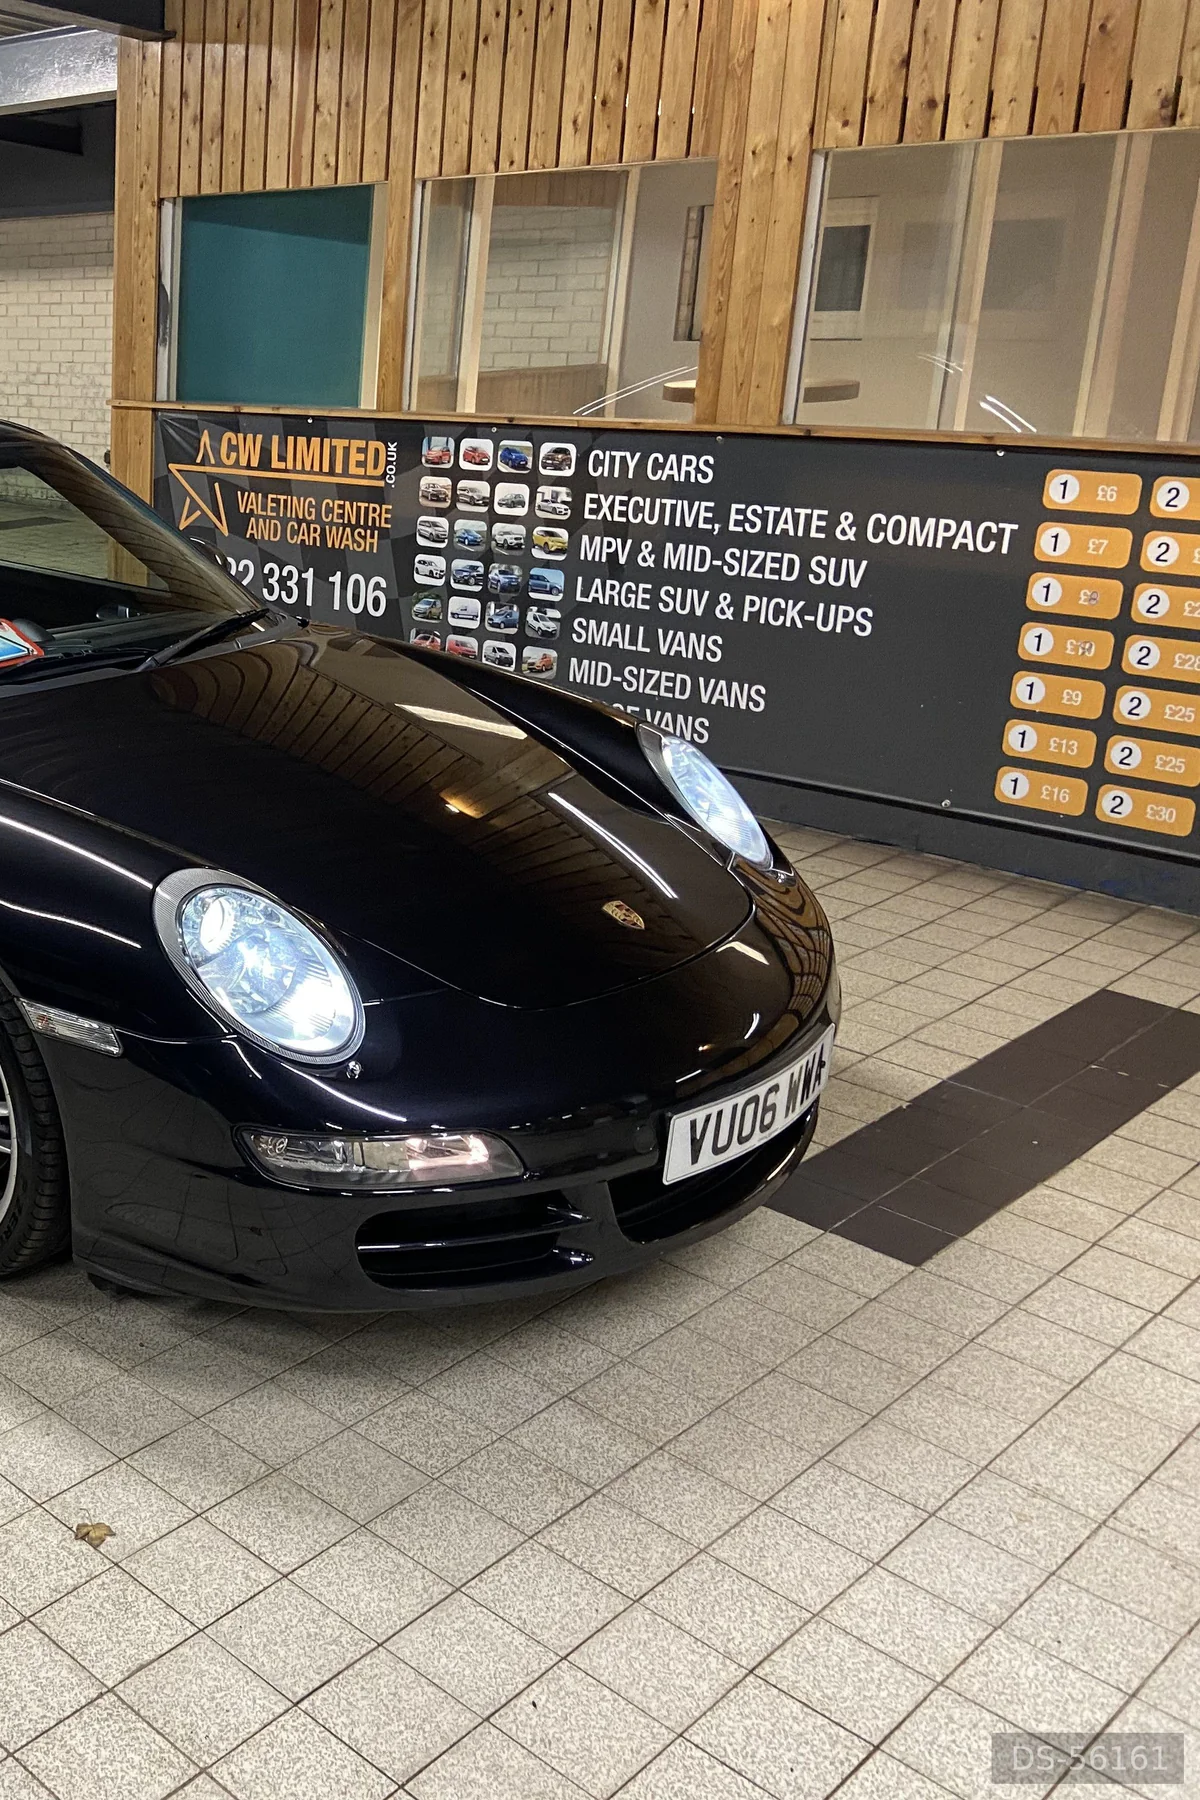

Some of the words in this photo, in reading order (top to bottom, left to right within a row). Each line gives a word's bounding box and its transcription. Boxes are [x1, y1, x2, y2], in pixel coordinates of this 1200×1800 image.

[220, 432, 262, 467] CW
[271, 435, 387, 477] LIMITED
[386, 441, 397, 488] .CO.UK
[588, 450, 641, 479] CITY
[647, 453, 714, 484] CARS
[1060, 480, 1068, 499] 1
[1096, 485, 1118, 502] £6
[1165, 487, 1180, 507] 2
[237, 491, 315, 520] VALETING
[321, 499, 392, 528] CENTRE
[246, 517, 281, 542] AND
[286, 521, 320, 547] CAR
[325, 525, 378, 553] WASH
[584, 493, 721, 535] EXECUTIVE,
[728, 505, 827, 540] ESTATE
[835, 512, 856, 542] &
[866, 513, 1019, 555] COMPACT
[1051, 533, 1059, 552] 1
[1087, 538, 1109, 555] £7
[1155, 542, 1170, 562] 2
[580, 535, 633, 565] MPV
[637, 540, 656, 567] &
[663, 543, 800, 583] MID-SIZED
[808, 555, 868, 589] SUV
[262, 562, 314, 607] 331
[328, 571, 387, 617] 106
[1043, 583, 1051, 602] 1
[575, 577, 652, 611] LARGE
[659, 585, 709, 616] SUV
[715, 593, 734, 621] &
[742, 595, 873, 637] PICK-UPS
[1146, 594, 1161, 614] 2
[572, 618, 650, 652] SMALL
[658, 628, 723, 662] VANS
[1035, 633, 1043, 651] 1
[1137, 646, 1151, 666] 2
[568, 658, 692, 701] MID-SIZED
[698, 677, 766, 712] VANS
[1026, 682, 1035, 700] 1
[1061, 689, 1082, 706] £9
[1127, 696, 1142, 716] 2
[1163, 704, 1196, 723] £25
[1018, 730, 1027, 749] 1
[1049, 737, 1078, 755] £13
[1119, 747, 1133, 766] 2
[1154, 754, 1186, 774] £25
[1010, 777, 1019, 795] 1
[1041, 785, 1070, 803] £16
[1109, 795, 1124, 815] 2
[1145, 804, 1176, 824] £30
[689, 1083, 779, 1166] VU06
